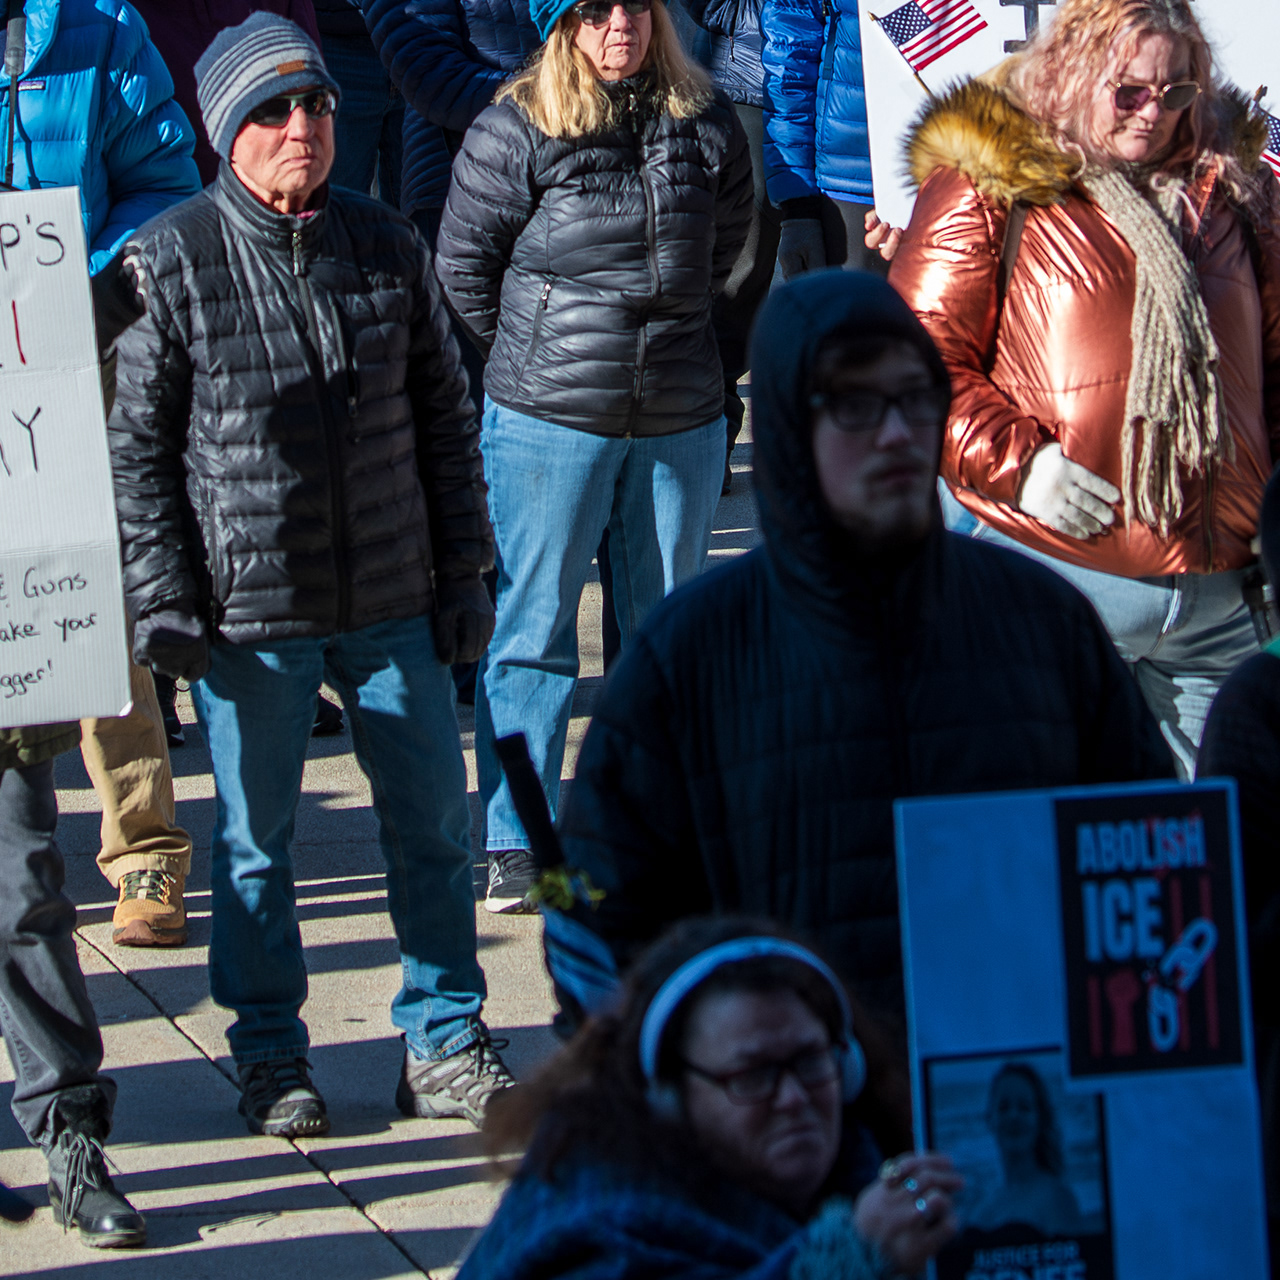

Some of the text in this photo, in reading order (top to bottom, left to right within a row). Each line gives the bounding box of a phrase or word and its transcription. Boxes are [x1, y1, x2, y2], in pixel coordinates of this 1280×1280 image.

[23, 568, 89, 602] Guns
[53, 612, 98, 646] your
[1076, 817, 1207, 875] ABOLISH
[1081, 878, 1164, 962] ICE
